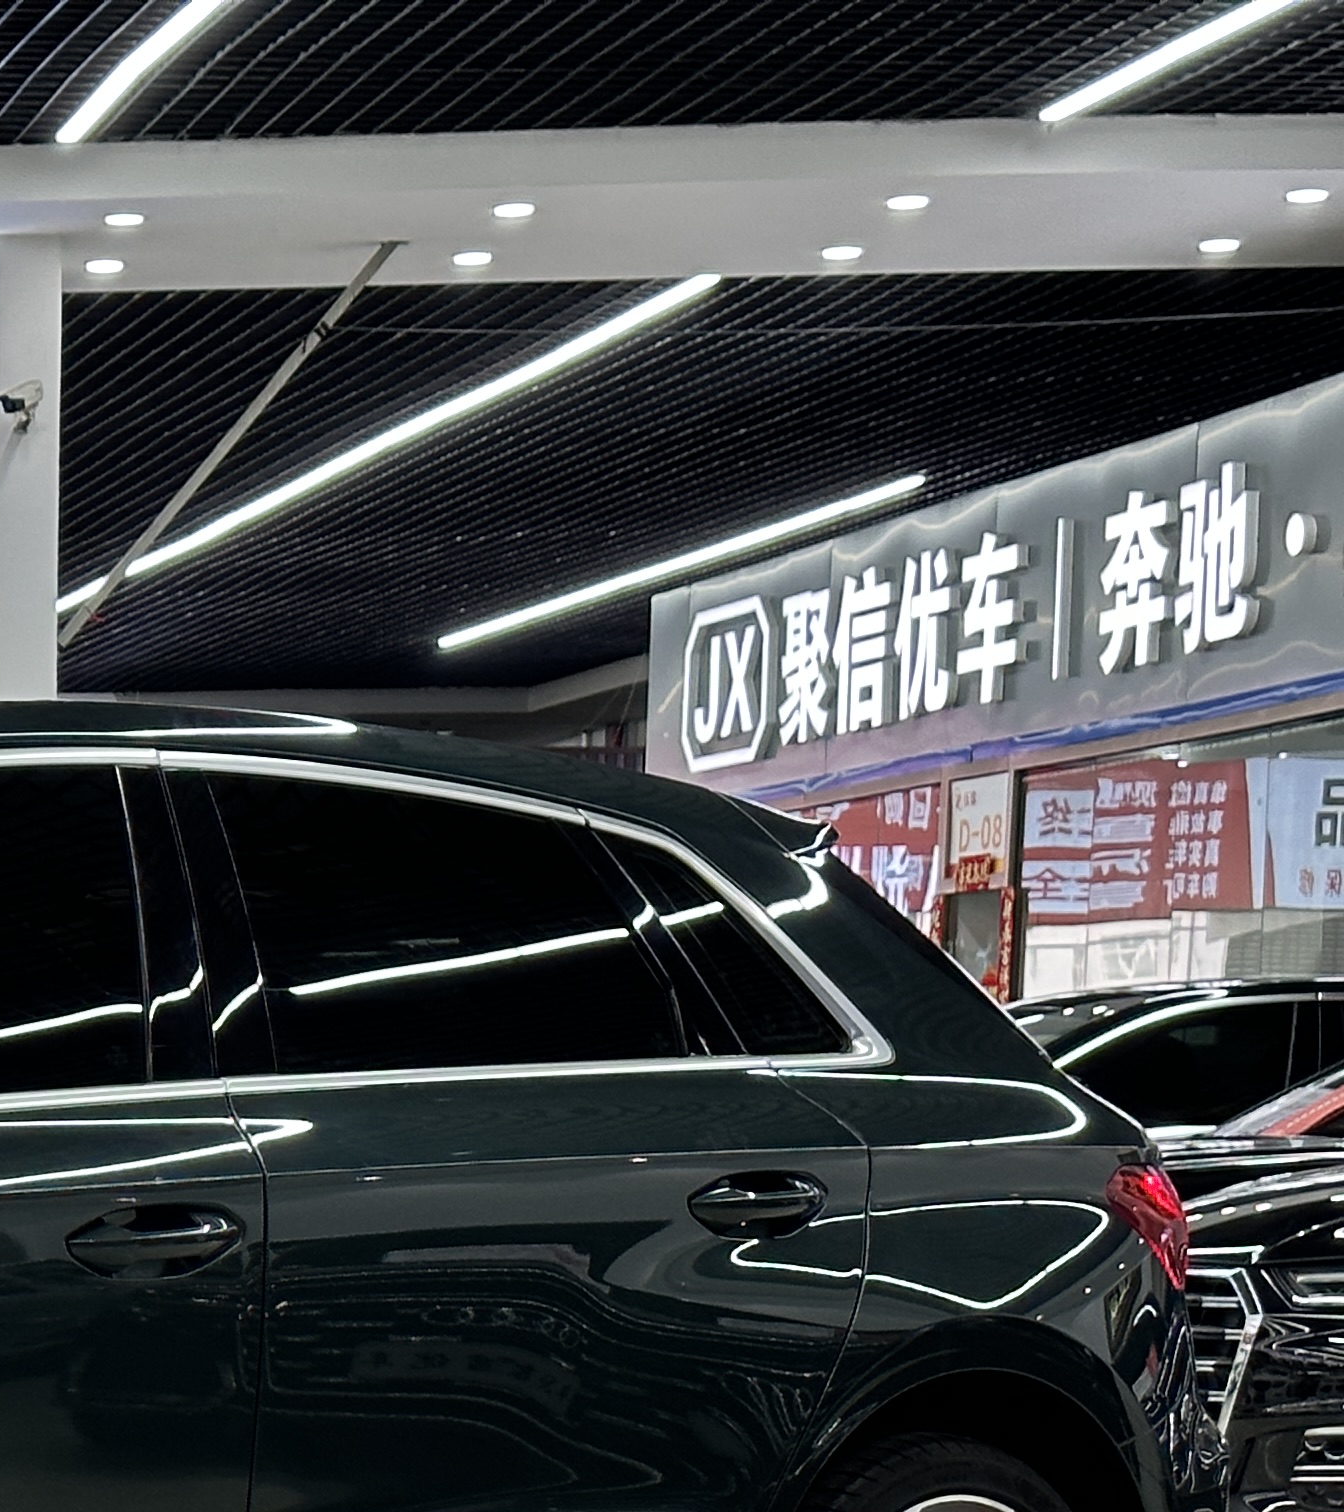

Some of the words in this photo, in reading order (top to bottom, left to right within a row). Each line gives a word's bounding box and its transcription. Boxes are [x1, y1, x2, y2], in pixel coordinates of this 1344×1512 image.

[693, 624, 757, 744] JX
[777, 531, 1022, 747] 聚信优车
